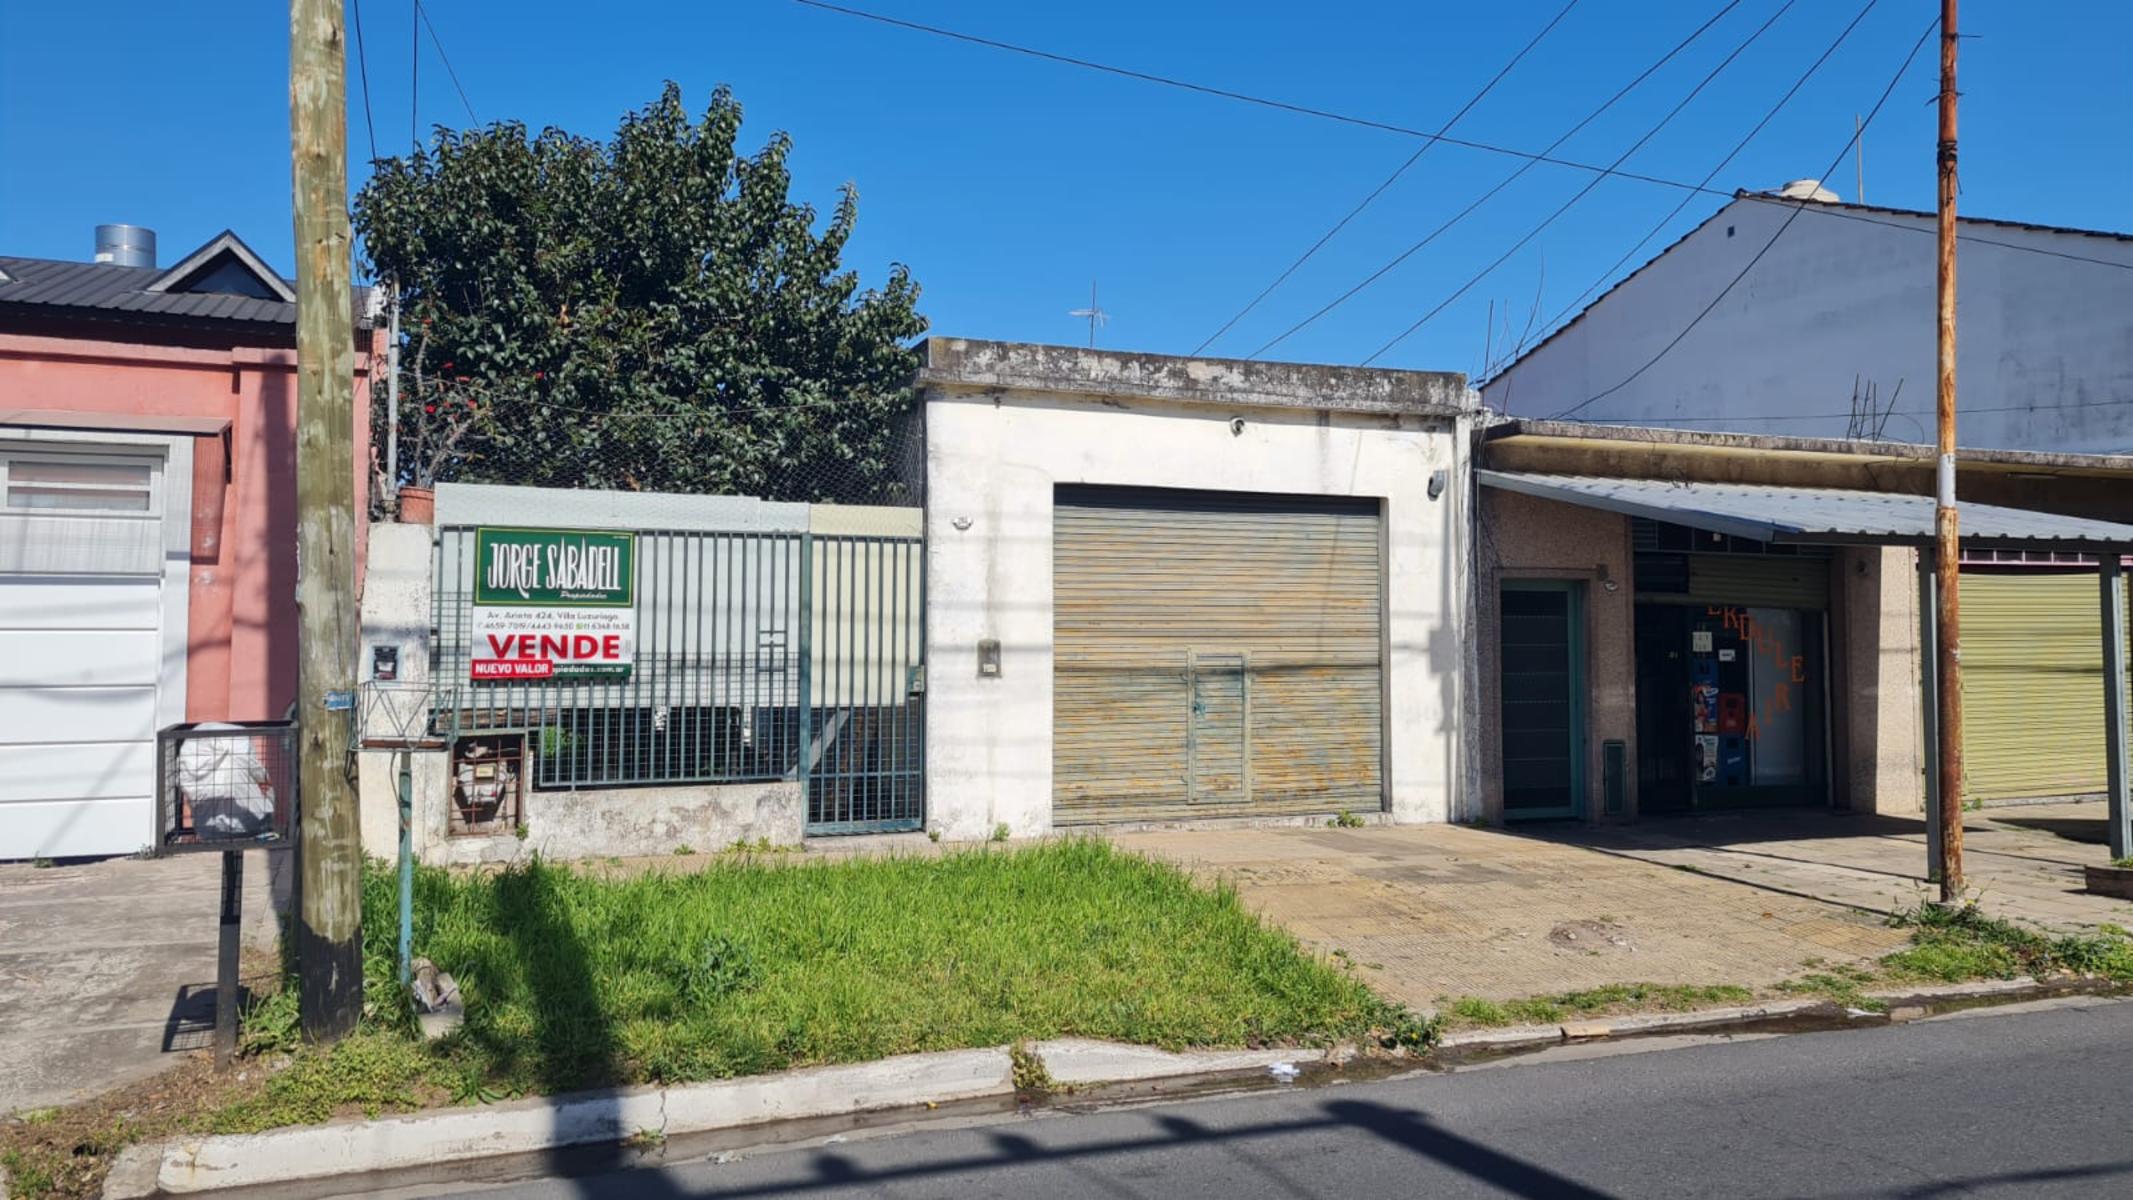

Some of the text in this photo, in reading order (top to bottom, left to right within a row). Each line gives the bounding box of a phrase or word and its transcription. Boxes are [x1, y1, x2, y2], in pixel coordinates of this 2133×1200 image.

[487, 536, 622, 599] JORGE SABADELL
[487, 611, 502, 620] Av.
[556, 611, 576, 620] Villa
[486, 634, 621, 660] VENDE
[474, 663, 549, 675] NUEVO VALOR
